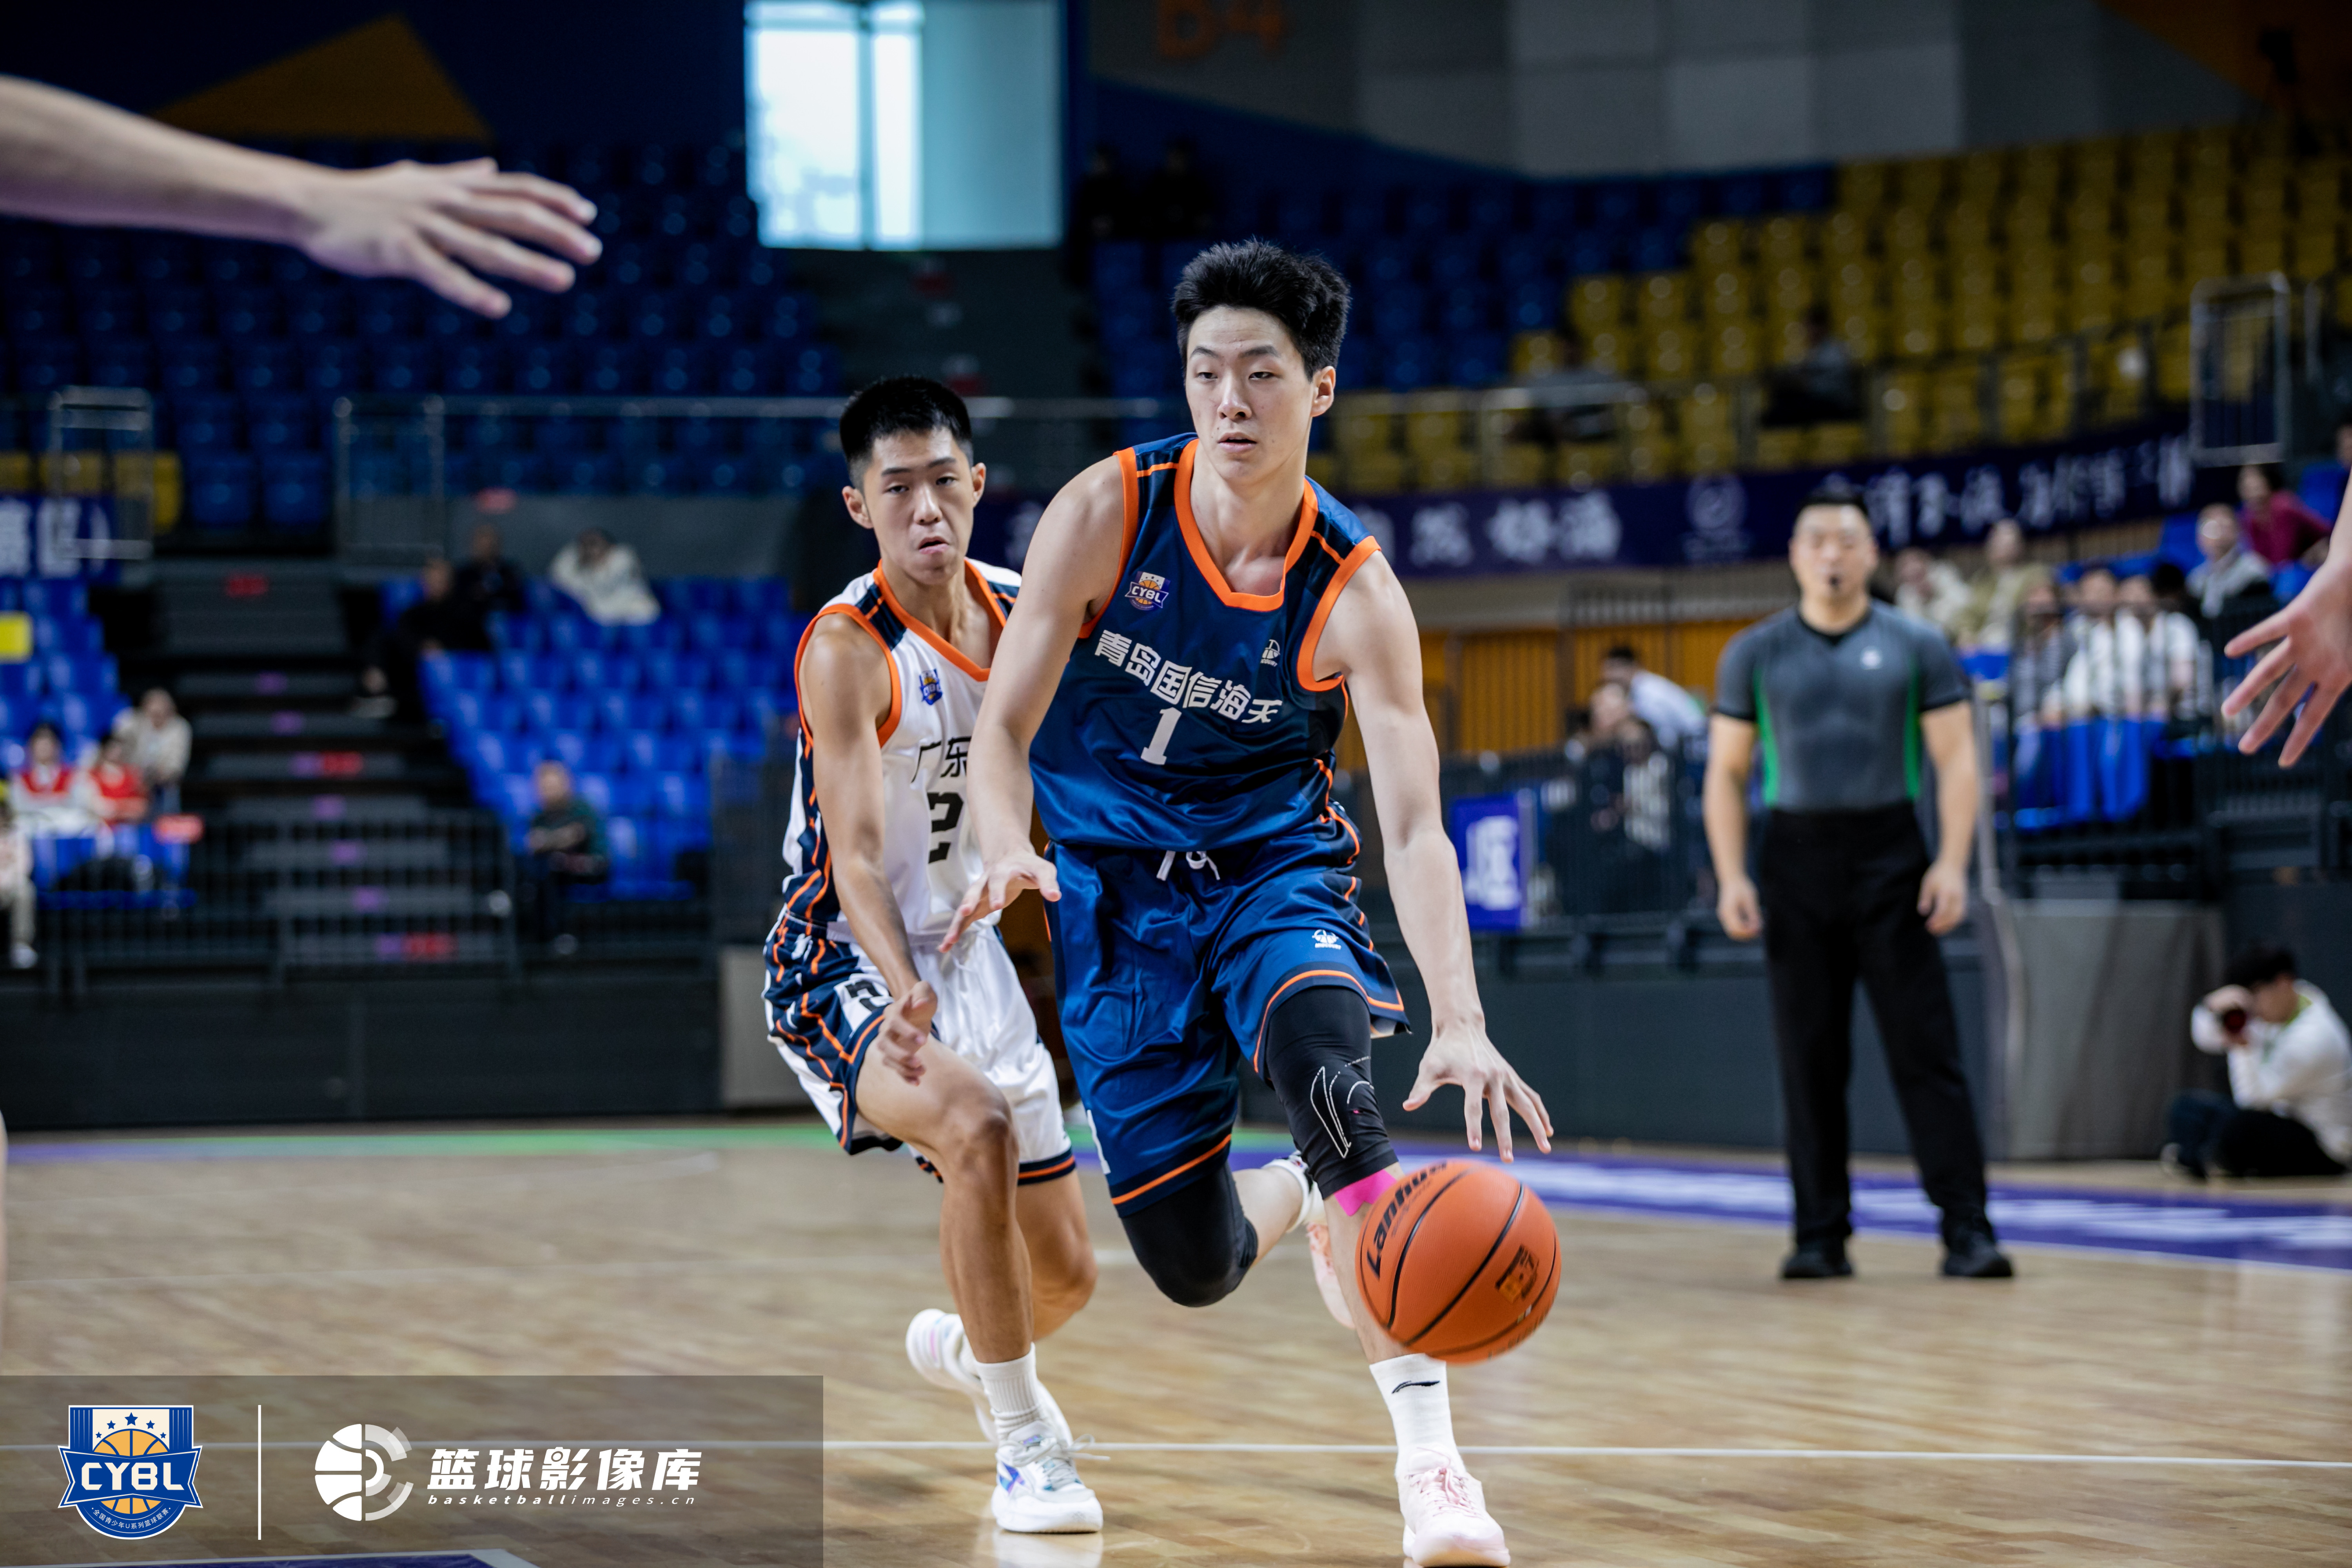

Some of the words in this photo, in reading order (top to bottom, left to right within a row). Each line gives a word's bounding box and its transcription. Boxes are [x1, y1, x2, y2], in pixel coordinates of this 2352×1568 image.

[1131, 586, 1161, 603] CYBL
[1094, 629, 1283, 724] 青岛国信海天
[911, 736, 972, 783] 广东
[1140, 707, 1182, 766] 1
